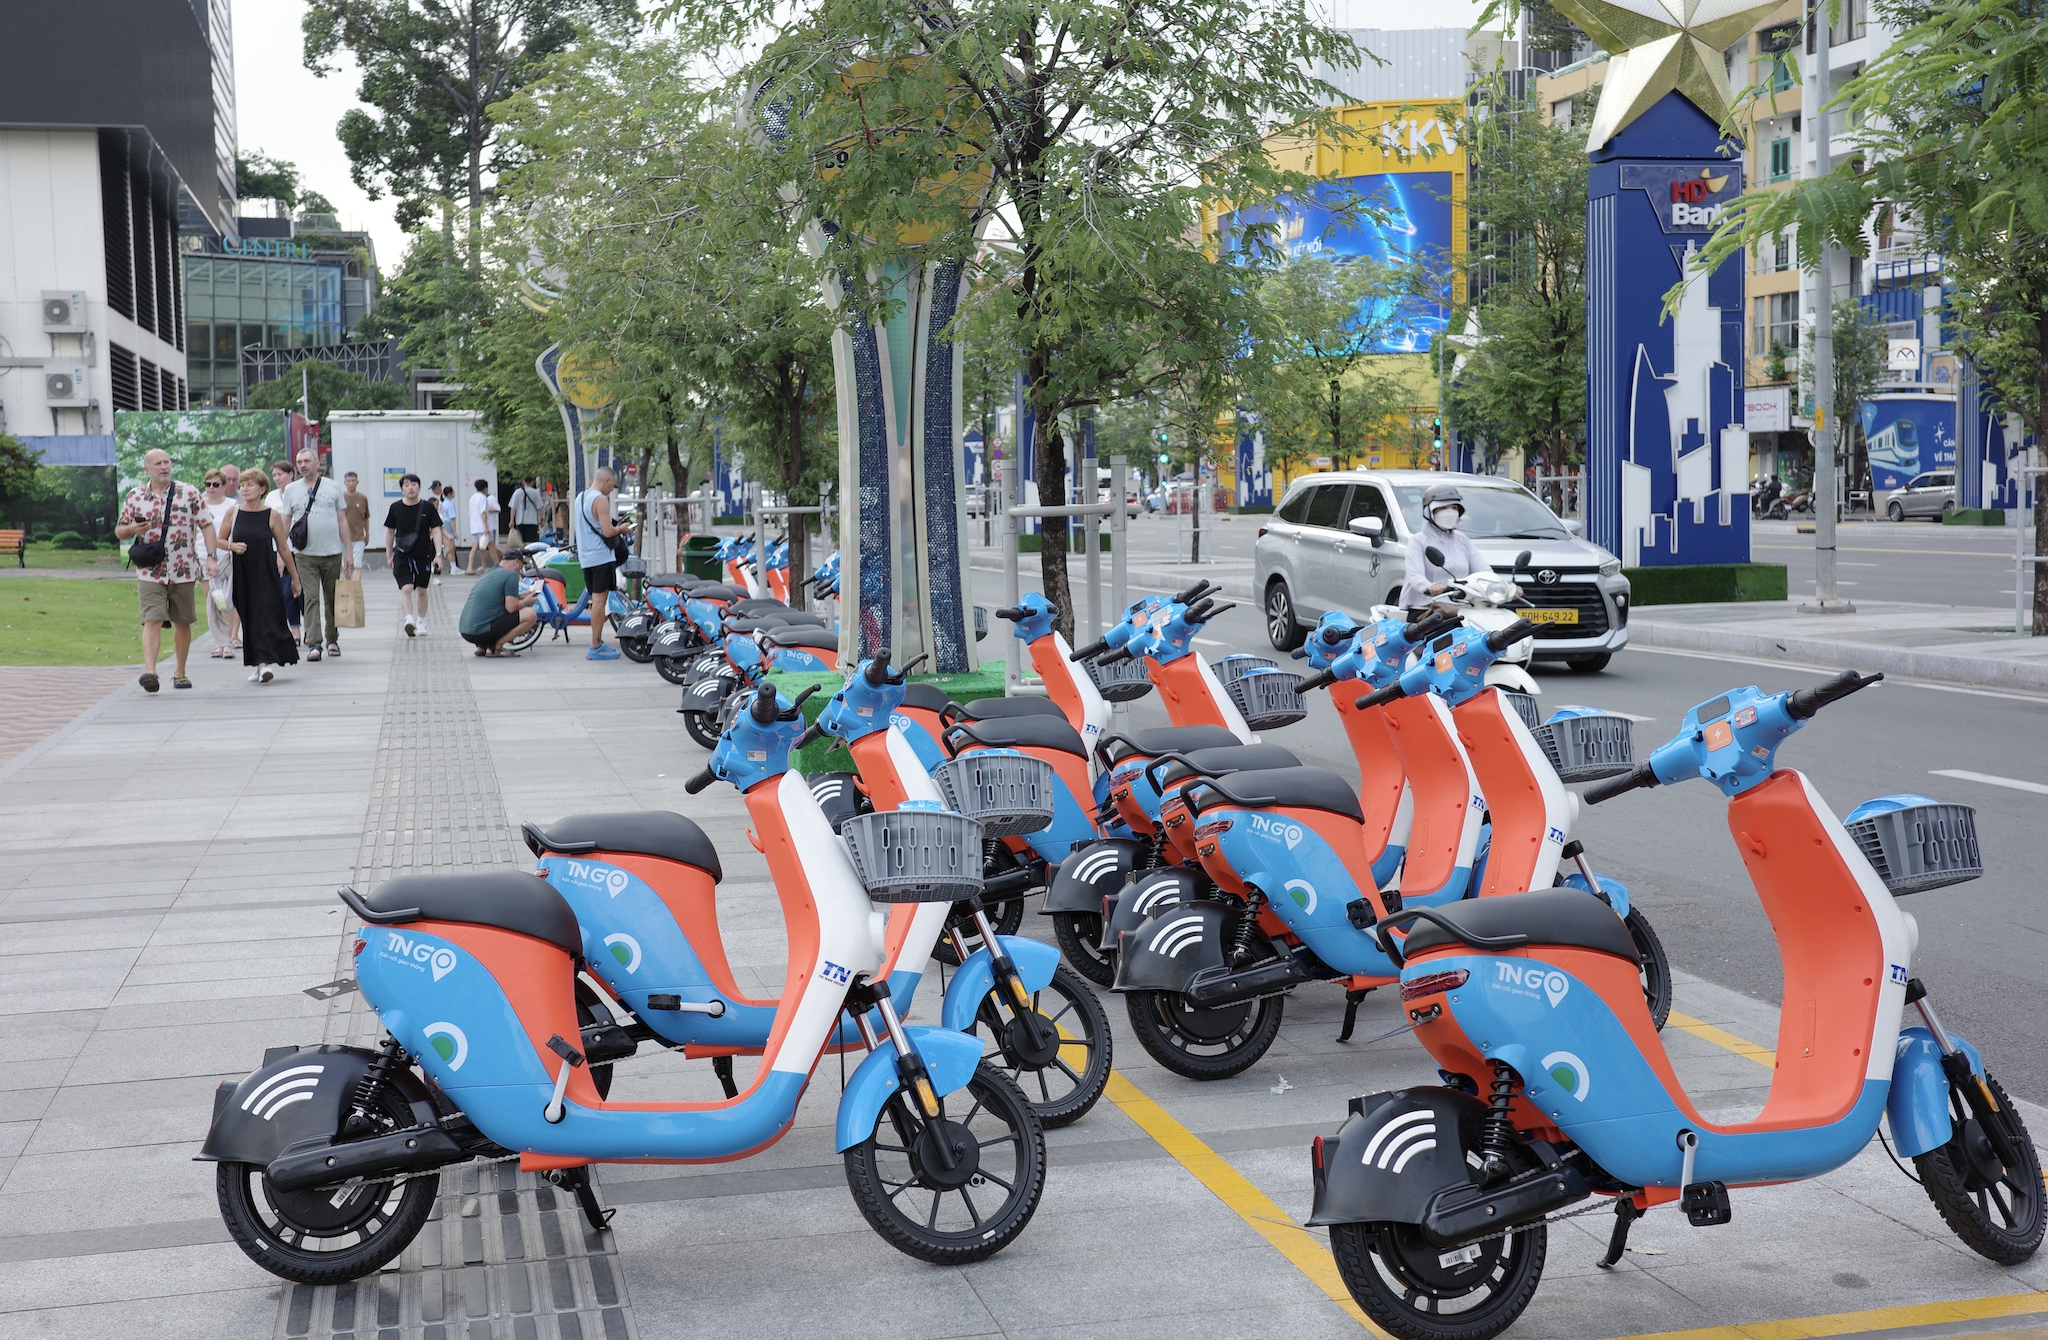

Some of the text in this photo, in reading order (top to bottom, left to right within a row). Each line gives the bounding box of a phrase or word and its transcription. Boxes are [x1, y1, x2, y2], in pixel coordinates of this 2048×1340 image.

[1382, 119, 1464, 157] KKV
[1671, 180, 1707, 203] HD
[1744, 402, 1778, 412] BOOK
[822, 960, 852, 984] TN
